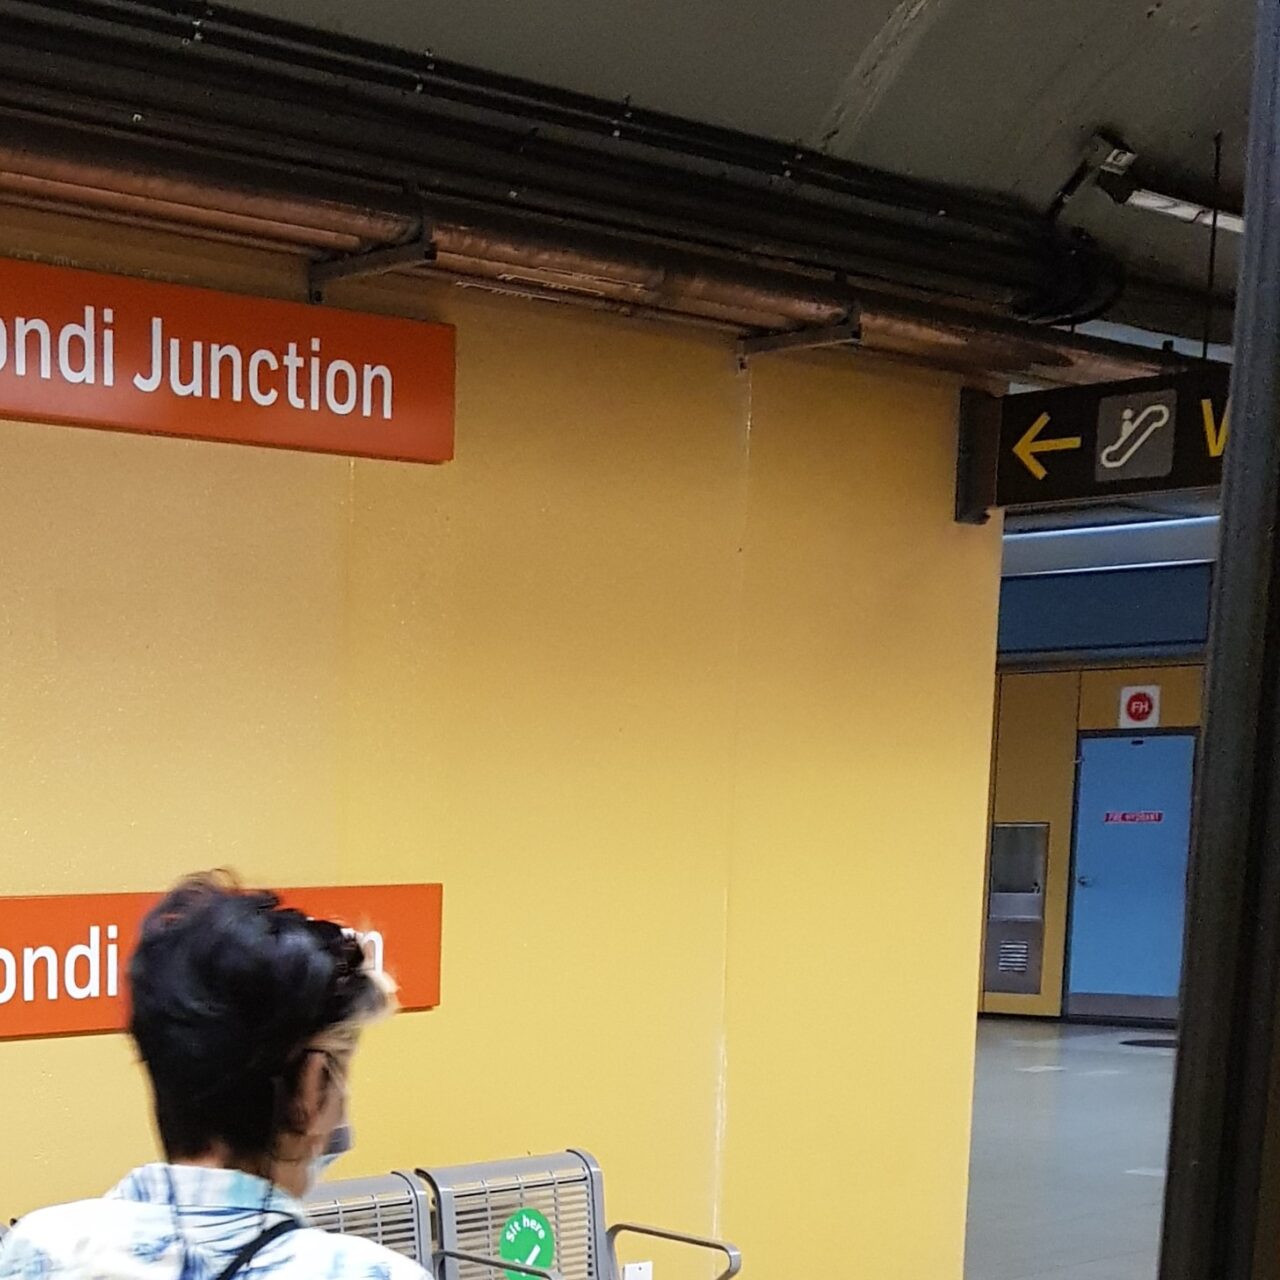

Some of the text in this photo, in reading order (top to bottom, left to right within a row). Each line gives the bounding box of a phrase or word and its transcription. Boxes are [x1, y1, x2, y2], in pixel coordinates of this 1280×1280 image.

[133, 317, 393, 419] Junction
[1131, 701, 1149, 713] FH
[506, 1214, 546, 1243] Sit here
